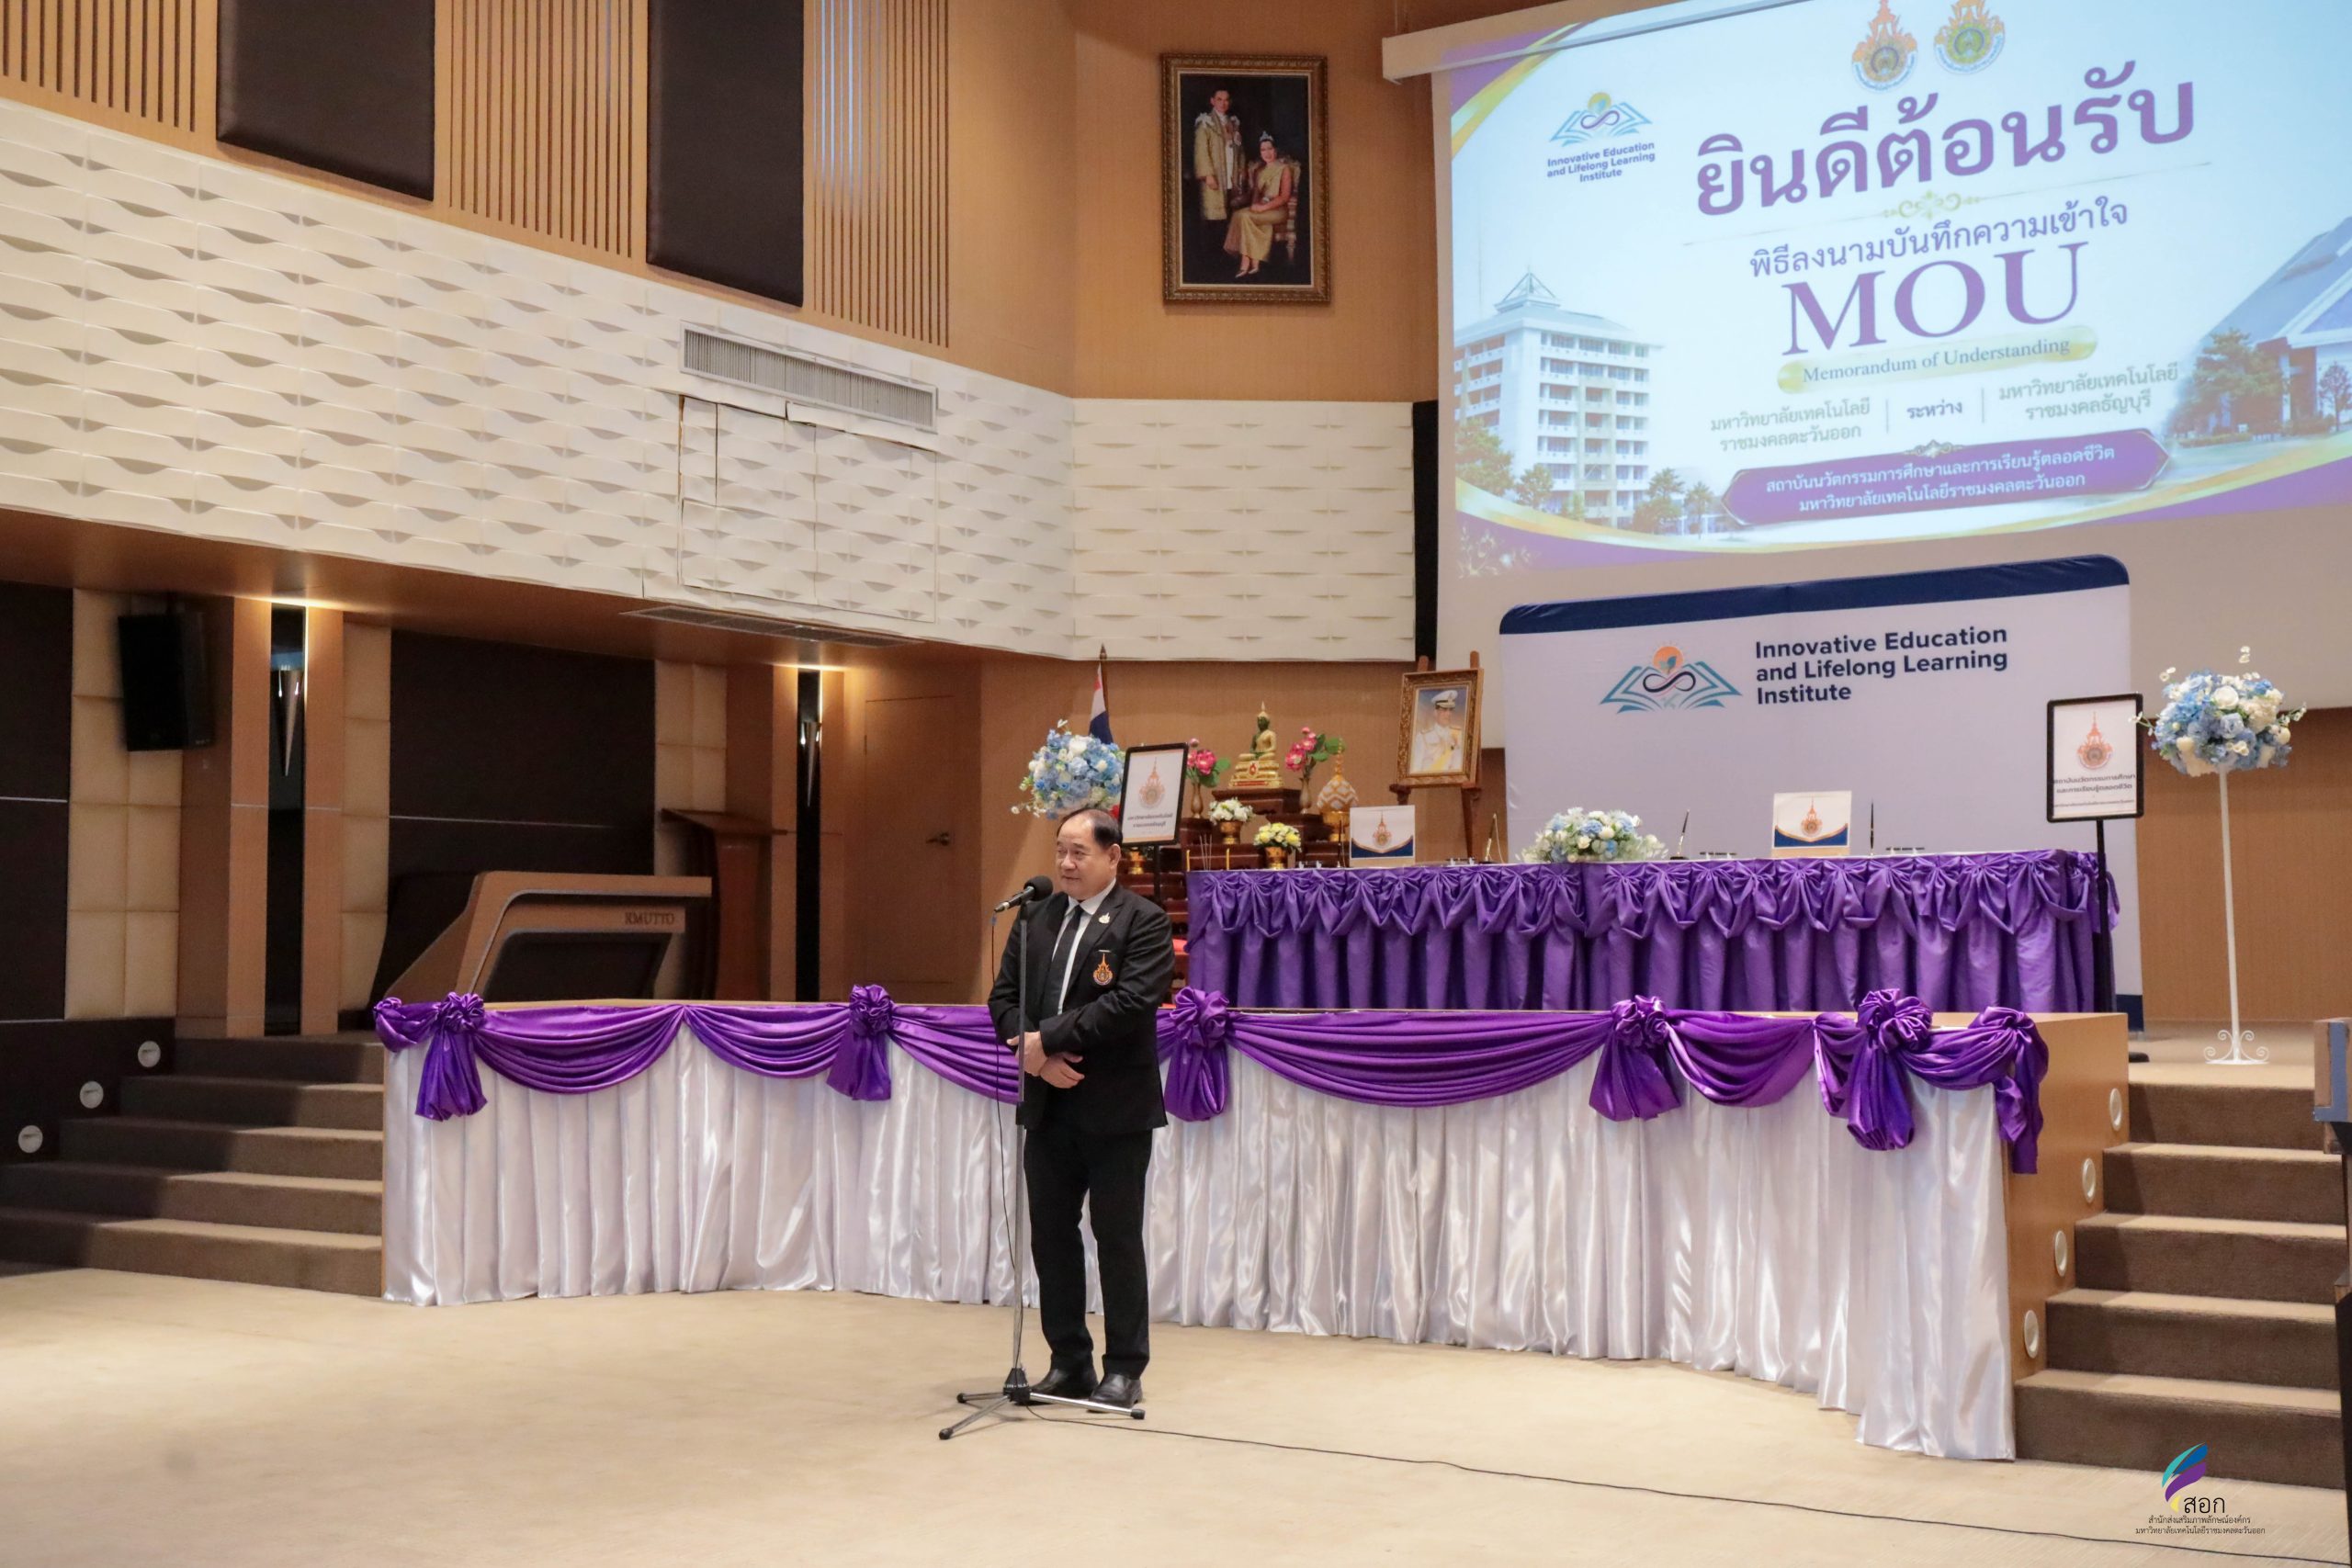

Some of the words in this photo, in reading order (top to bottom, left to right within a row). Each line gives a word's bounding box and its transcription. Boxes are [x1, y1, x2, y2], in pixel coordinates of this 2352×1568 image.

[1697, 60, 2194, 216] ยินดีต้อนรับ
[1547, 152, 1600, 167] Innovative
[1603, 142, 1655, 157] Education
[1547, 167, 1566, 177] and
[1568, 161, 1609, 174] Lifelong
[1611, 152, 1656, 166] Learning
[1579, 168, 1623, 182] Institute
[1749, 196, 2129, 277] พิธีลงนามบันทึกความเข้าใจ
[1781, 242, 2089, 356] MOU
[1803, 356, 1917, 383] Memorandum
[1921, 351, 1939, 368] of
[1943, 337, 2070, 367] Understanding
[1998, 362, 2178, 400] มหาวิทยาลัยเทคโนโลยี
[1711, 397, 1871, 432] มหาวิทยาลัยเทคโนโลยี
[1906, 399, 1962, 420] ระหว่าง
[2025, 389, 2152, 421] ราชมงคลธัญบุรี
[1720, 425, 1861, 452] ราชมงคลตะวันออก
[1799, 474, 2086, 512] มหาวิทยาลัยเทคโนโลยีราชมงคลตะวันออก
[1756, 635, 1877, 659] Innovative
[1885, 626, 2007, 650] Education
[1756, 662, 1797, 682] and
[1804, 659, 1895, 679] Lifelong
[1904, 650, 2008, 673] Learning
[1757, 684, 1852, 705] Institute
